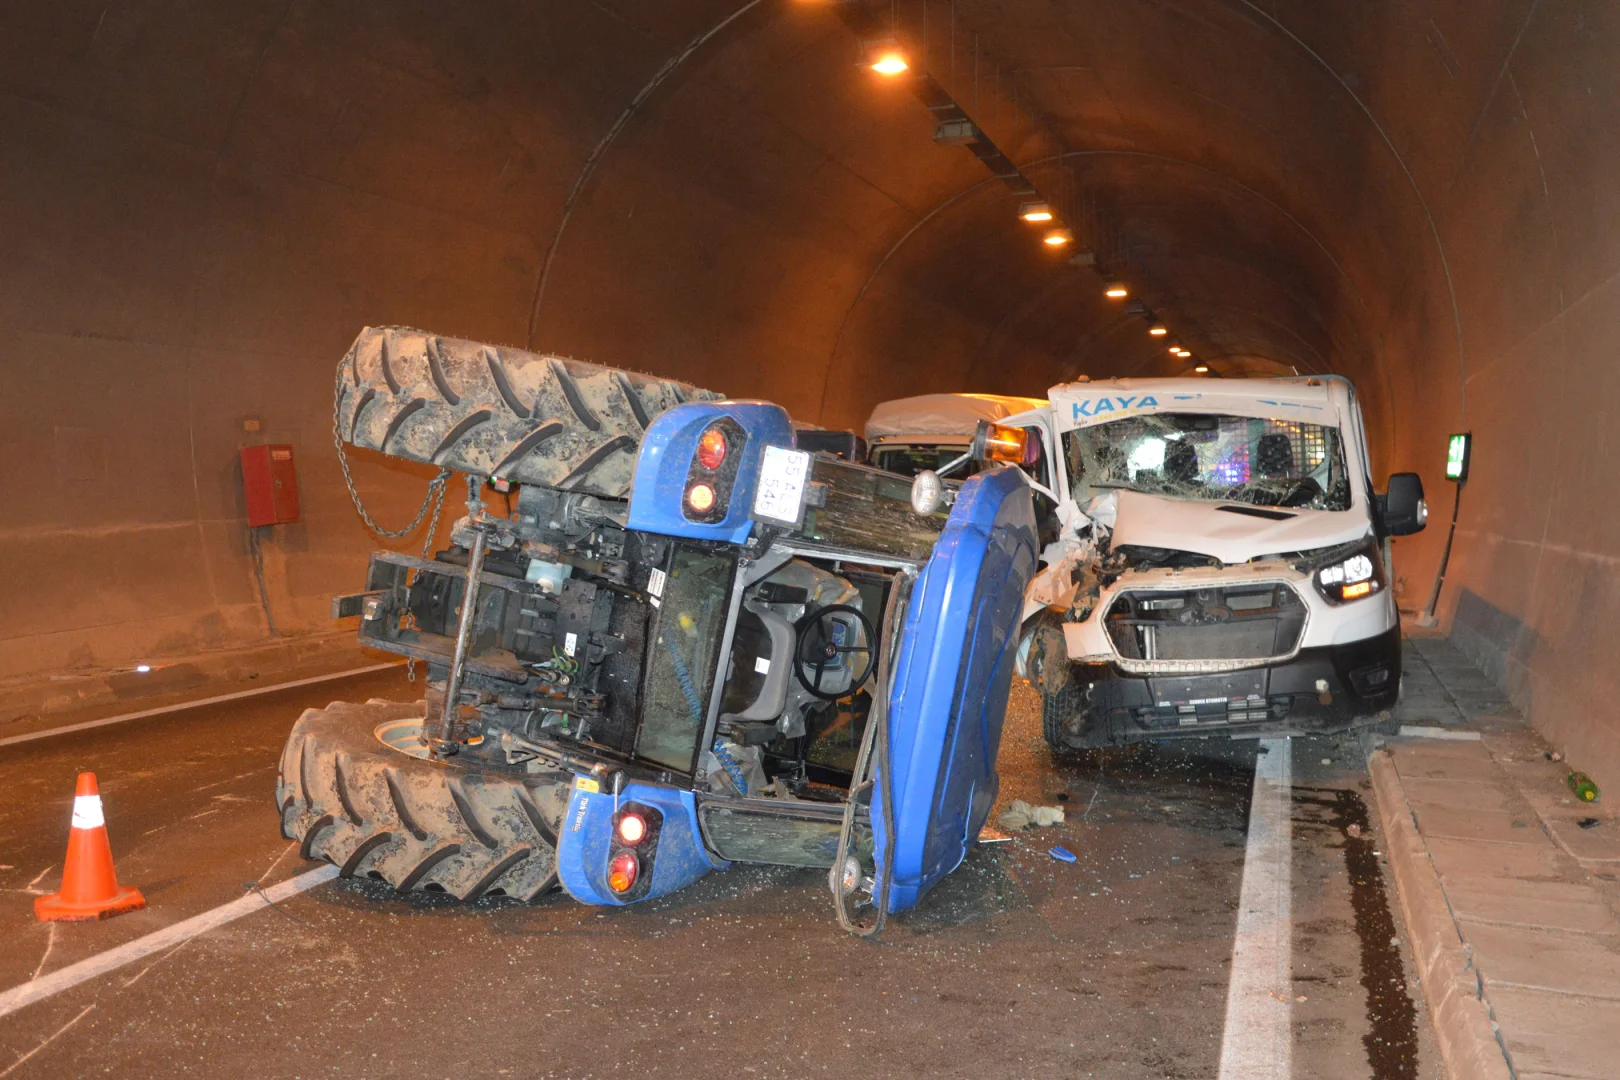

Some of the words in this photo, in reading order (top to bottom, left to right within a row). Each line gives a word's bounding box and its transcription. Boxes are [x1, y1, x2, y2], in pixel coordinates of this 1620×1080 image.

[1072, 396, 1158, 419] KAYA
[786, 456, 802, 476] 55
[761, 478, 779, 510] 546
